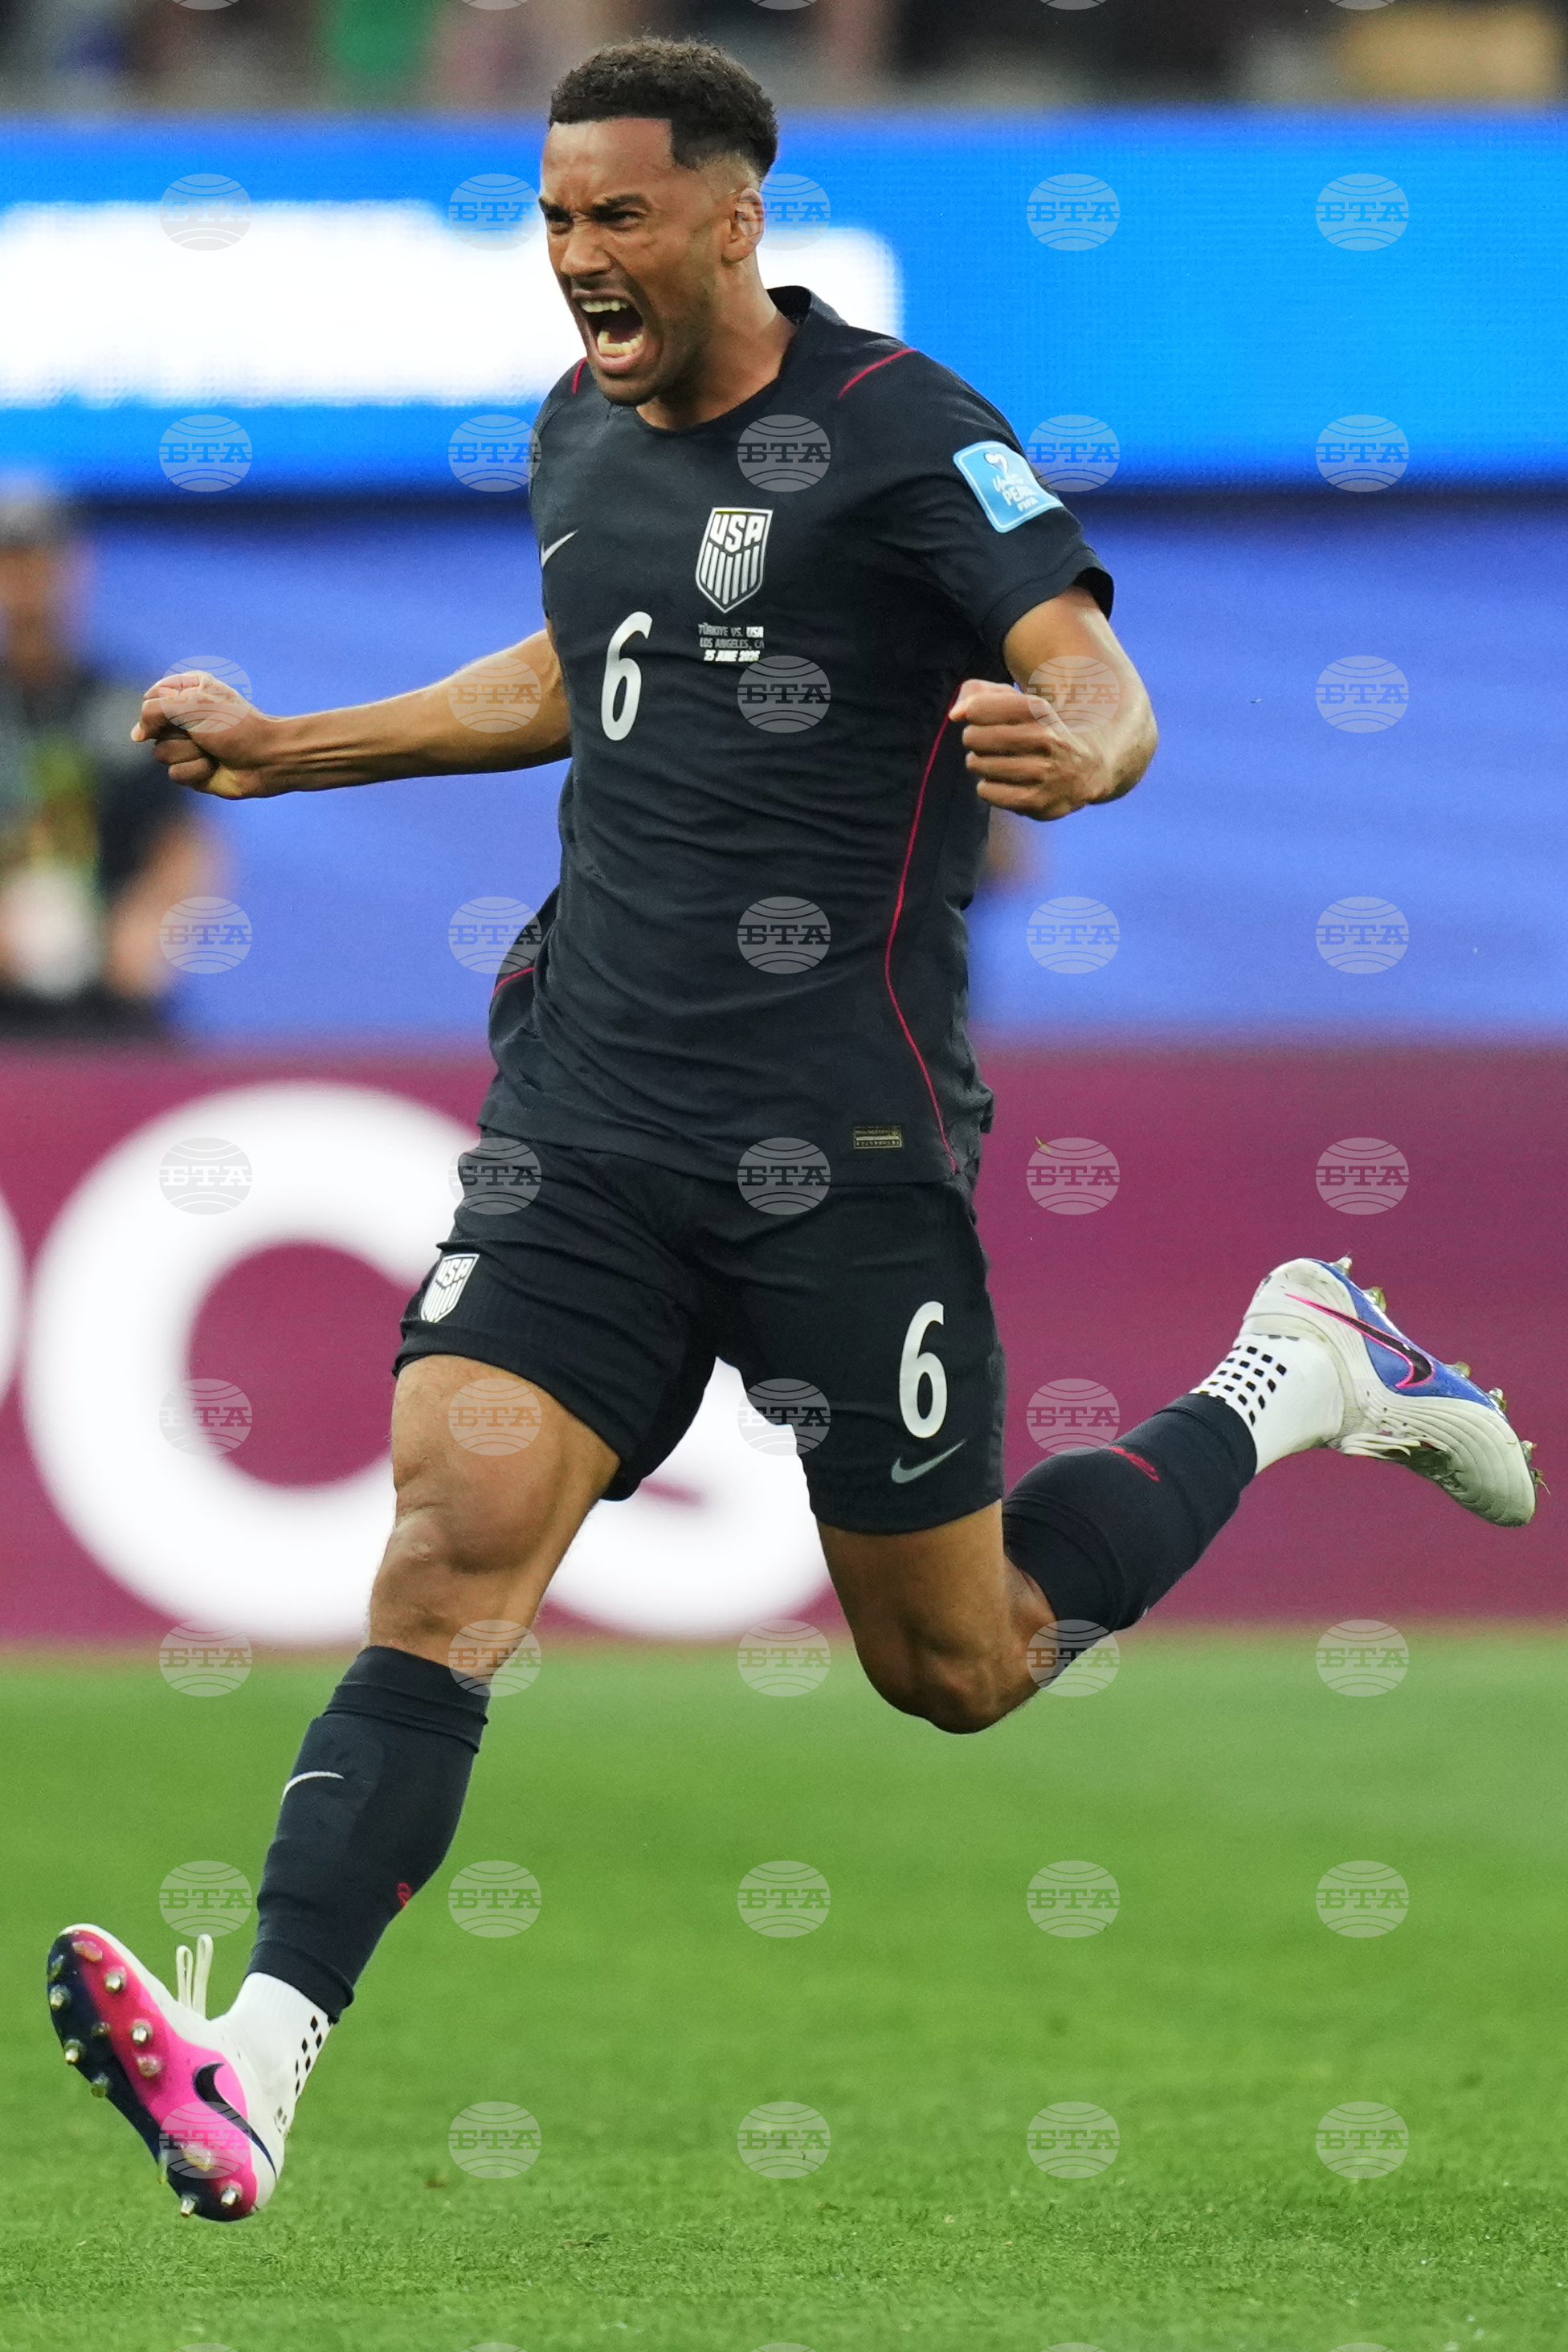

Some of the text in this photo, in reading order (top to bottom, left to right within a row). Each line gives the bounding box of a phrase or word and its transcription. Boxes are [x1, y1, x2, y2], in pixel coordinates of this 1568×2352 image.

[709, 513, 766, 553] USA
[699, 637, 713, 649] LOS
[753, 639, 765, 649] CA
[745, 626, 764, 639] USA
[601, 611, 652, 741] 6
[437, 1258, 474, 1287] USA
[899, 1301, 948, 1439] 6
